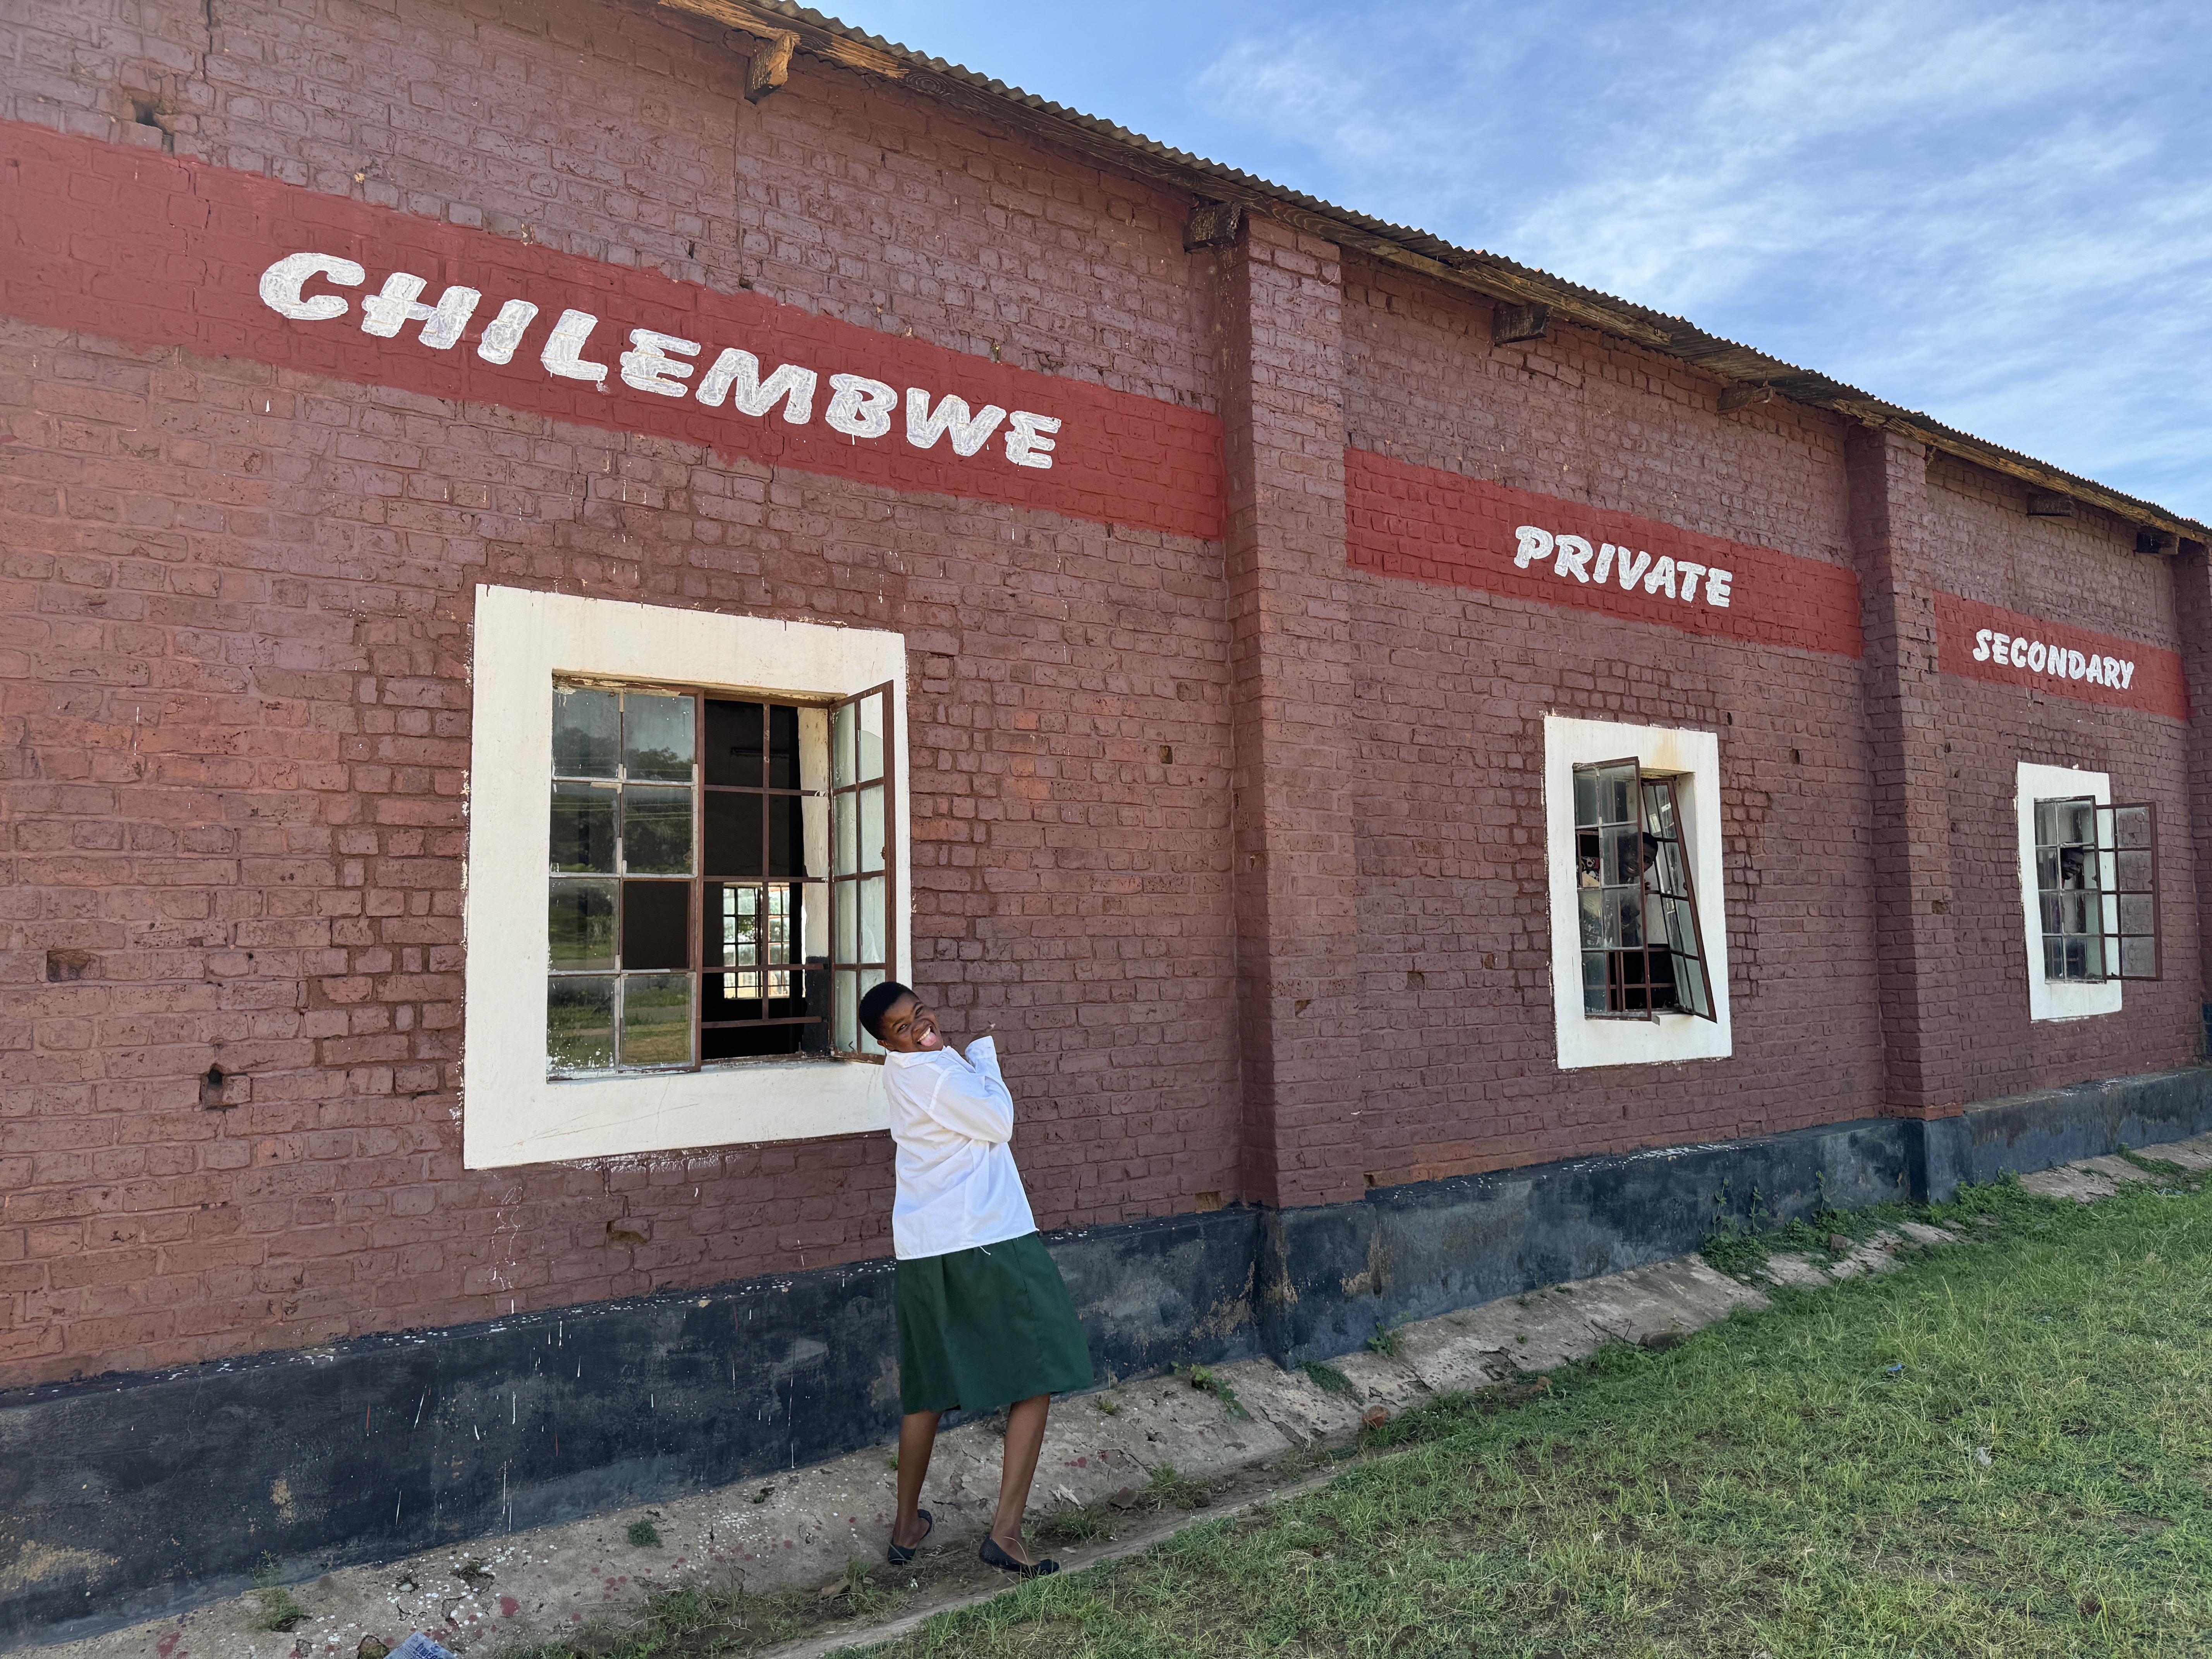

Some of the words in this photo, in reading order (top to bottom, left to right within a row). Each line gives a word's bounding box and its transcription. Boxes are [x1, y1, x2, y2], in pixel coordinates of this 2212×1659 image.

[259, 253, 1061, 469] CHILEMBWE
[1514, 526, 1732, 607] PRIVATE
[1973, 629, 2134, 689] SECONDARY
